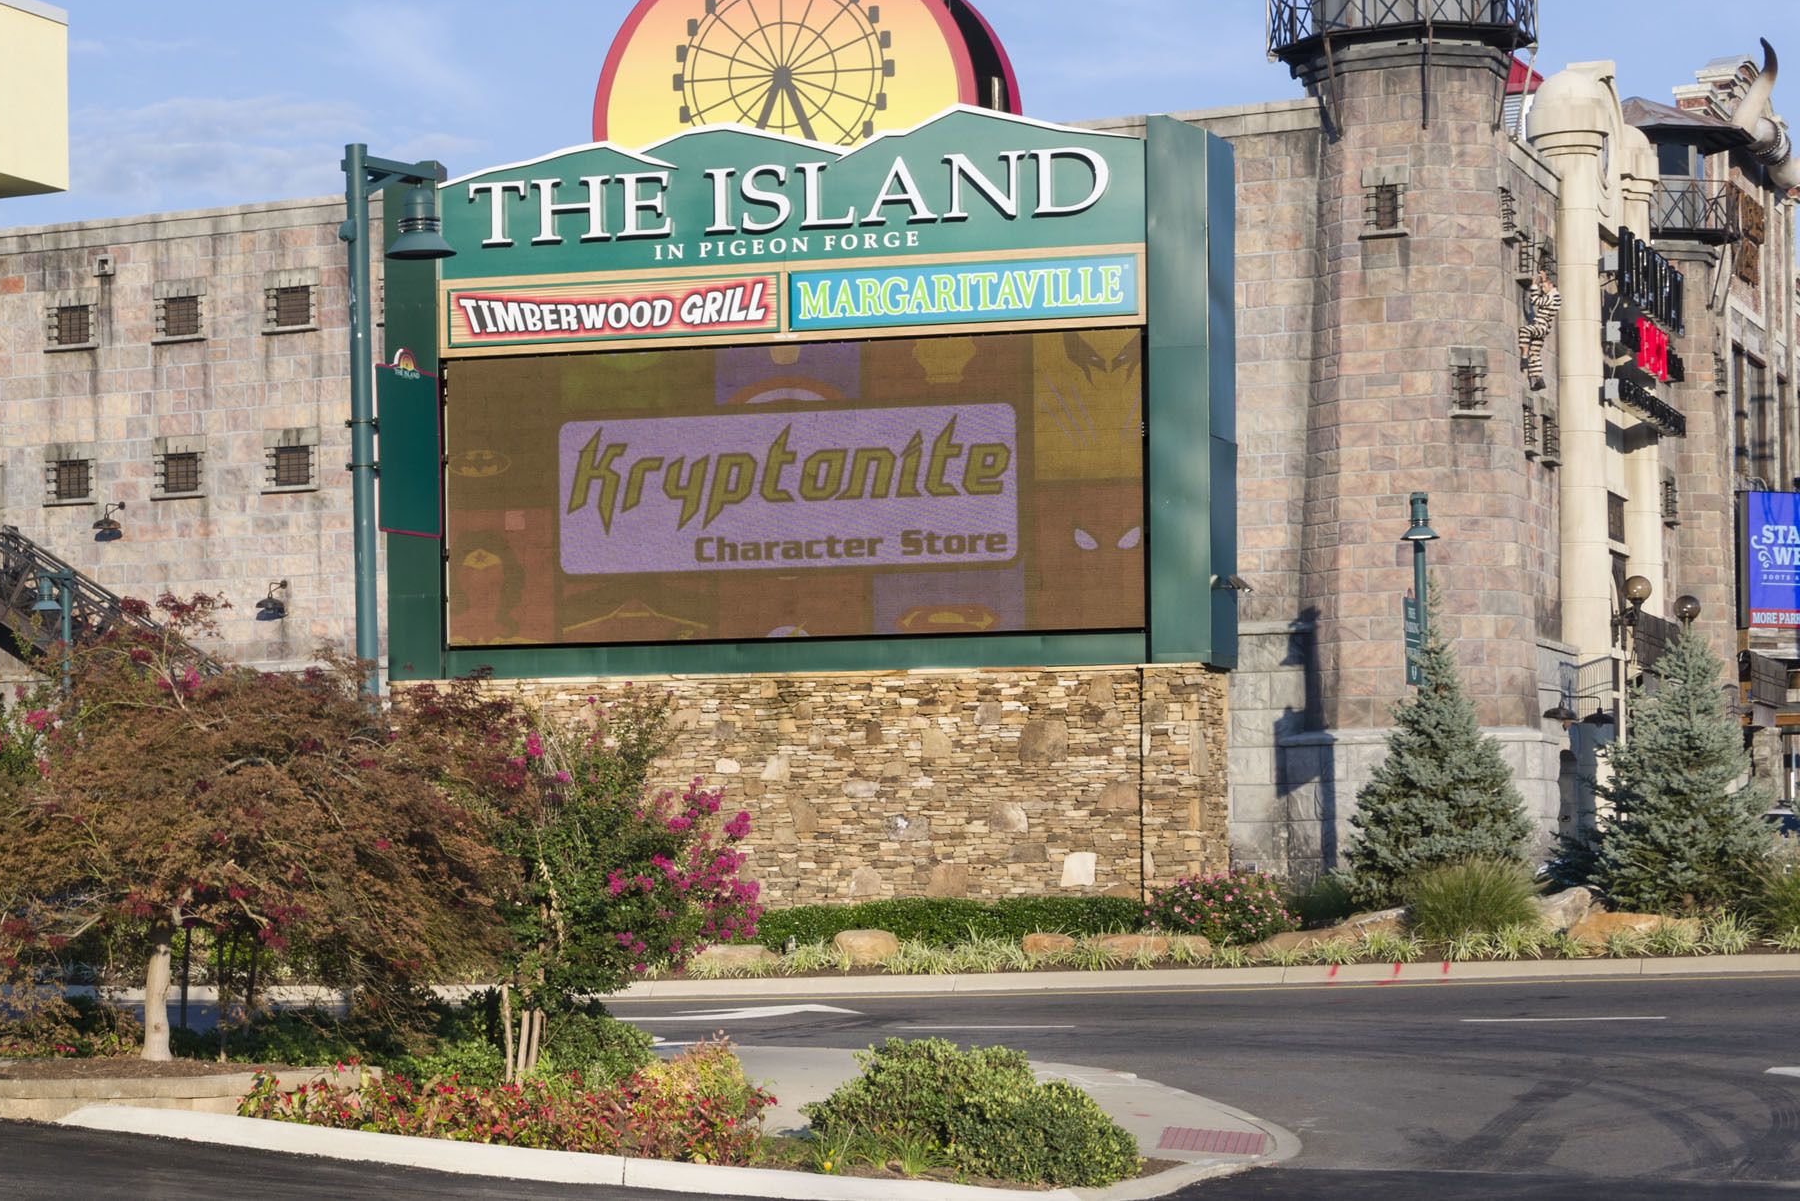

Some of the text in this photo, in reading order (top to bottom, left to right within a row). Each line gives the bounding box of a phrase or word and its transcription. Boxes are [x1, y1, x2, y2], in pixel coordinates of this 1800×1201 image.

[468, 146, 1111, 248] THE ISLAND
[654, 230, 920, 260] IN PIGEON FORGE
[457, 282, 770, 335] TIMBERWOOD GRILL
[796, 264, 1125, 320] MARGARITAVILLE
[566, 413, 1012, 536] Kryptonite
[693, 529, 1009, 564] Character Store
[1752, 612, 1777, 625] MORE
